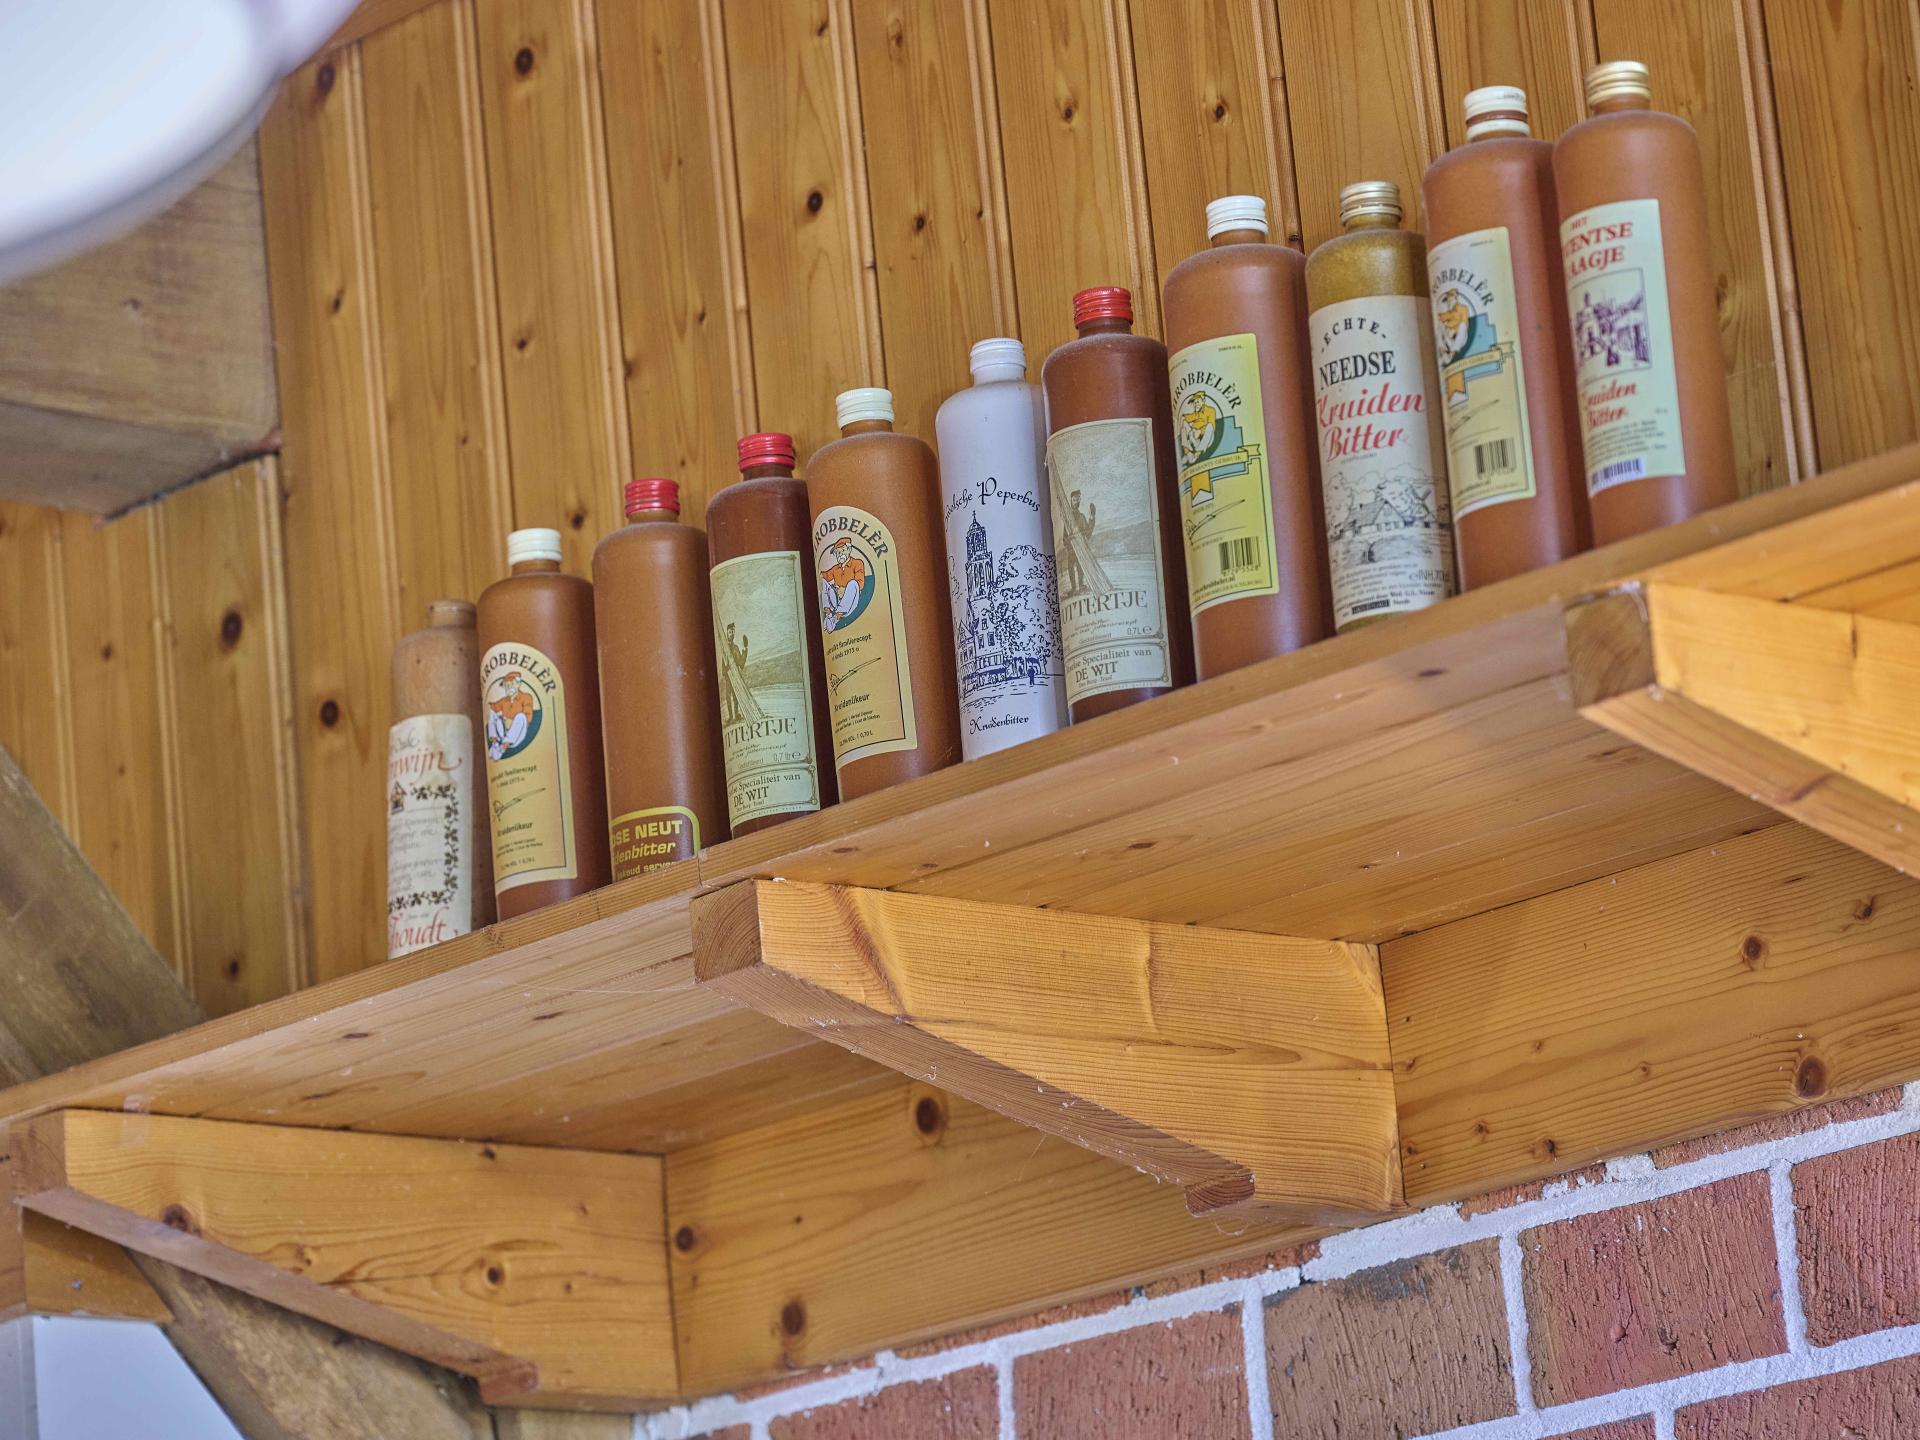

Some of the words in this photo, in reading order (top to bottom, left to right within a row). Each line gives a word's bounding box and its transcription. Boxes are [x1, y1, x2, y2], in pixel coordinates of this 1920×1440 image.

[1564, 221, 1633, 257] ENTSE
[1567, 244, 1625, 278] AAGJE
[1319, 350, 1397, 391] NEEDSE
[1171, 370, 1242, 411] HROBBELÈR
[1315, 382, 1427, 428] Kruiden
[1323, 423, 1409, 463] Bitter
[976, 476, 1041, 512] Peperbus
[813, 516, 889, 559] ROBBELÈR
[1061, 590, 1148, 625] UTTERTJE
[481, 651, 556, 693] ROBBELÈR
[1075, 667, 1088, 683] DE
[1091, 660, 1118, 678] WIT
[1082, 648, 1130, 667] Specialiteit
[723, 717, 798, 749] TTERTJE
[969, 713, 1029, 735] Kruidenbitter
[733, 793, 744, 808] DE
[746, 786, 769, 803] WIT
[738, 774, 780, 792] Specialiteit
[783, 774, 801, 782] van
[635, 820, 683, 840] NEUT
[614, 842, 676, 865] denbitter
